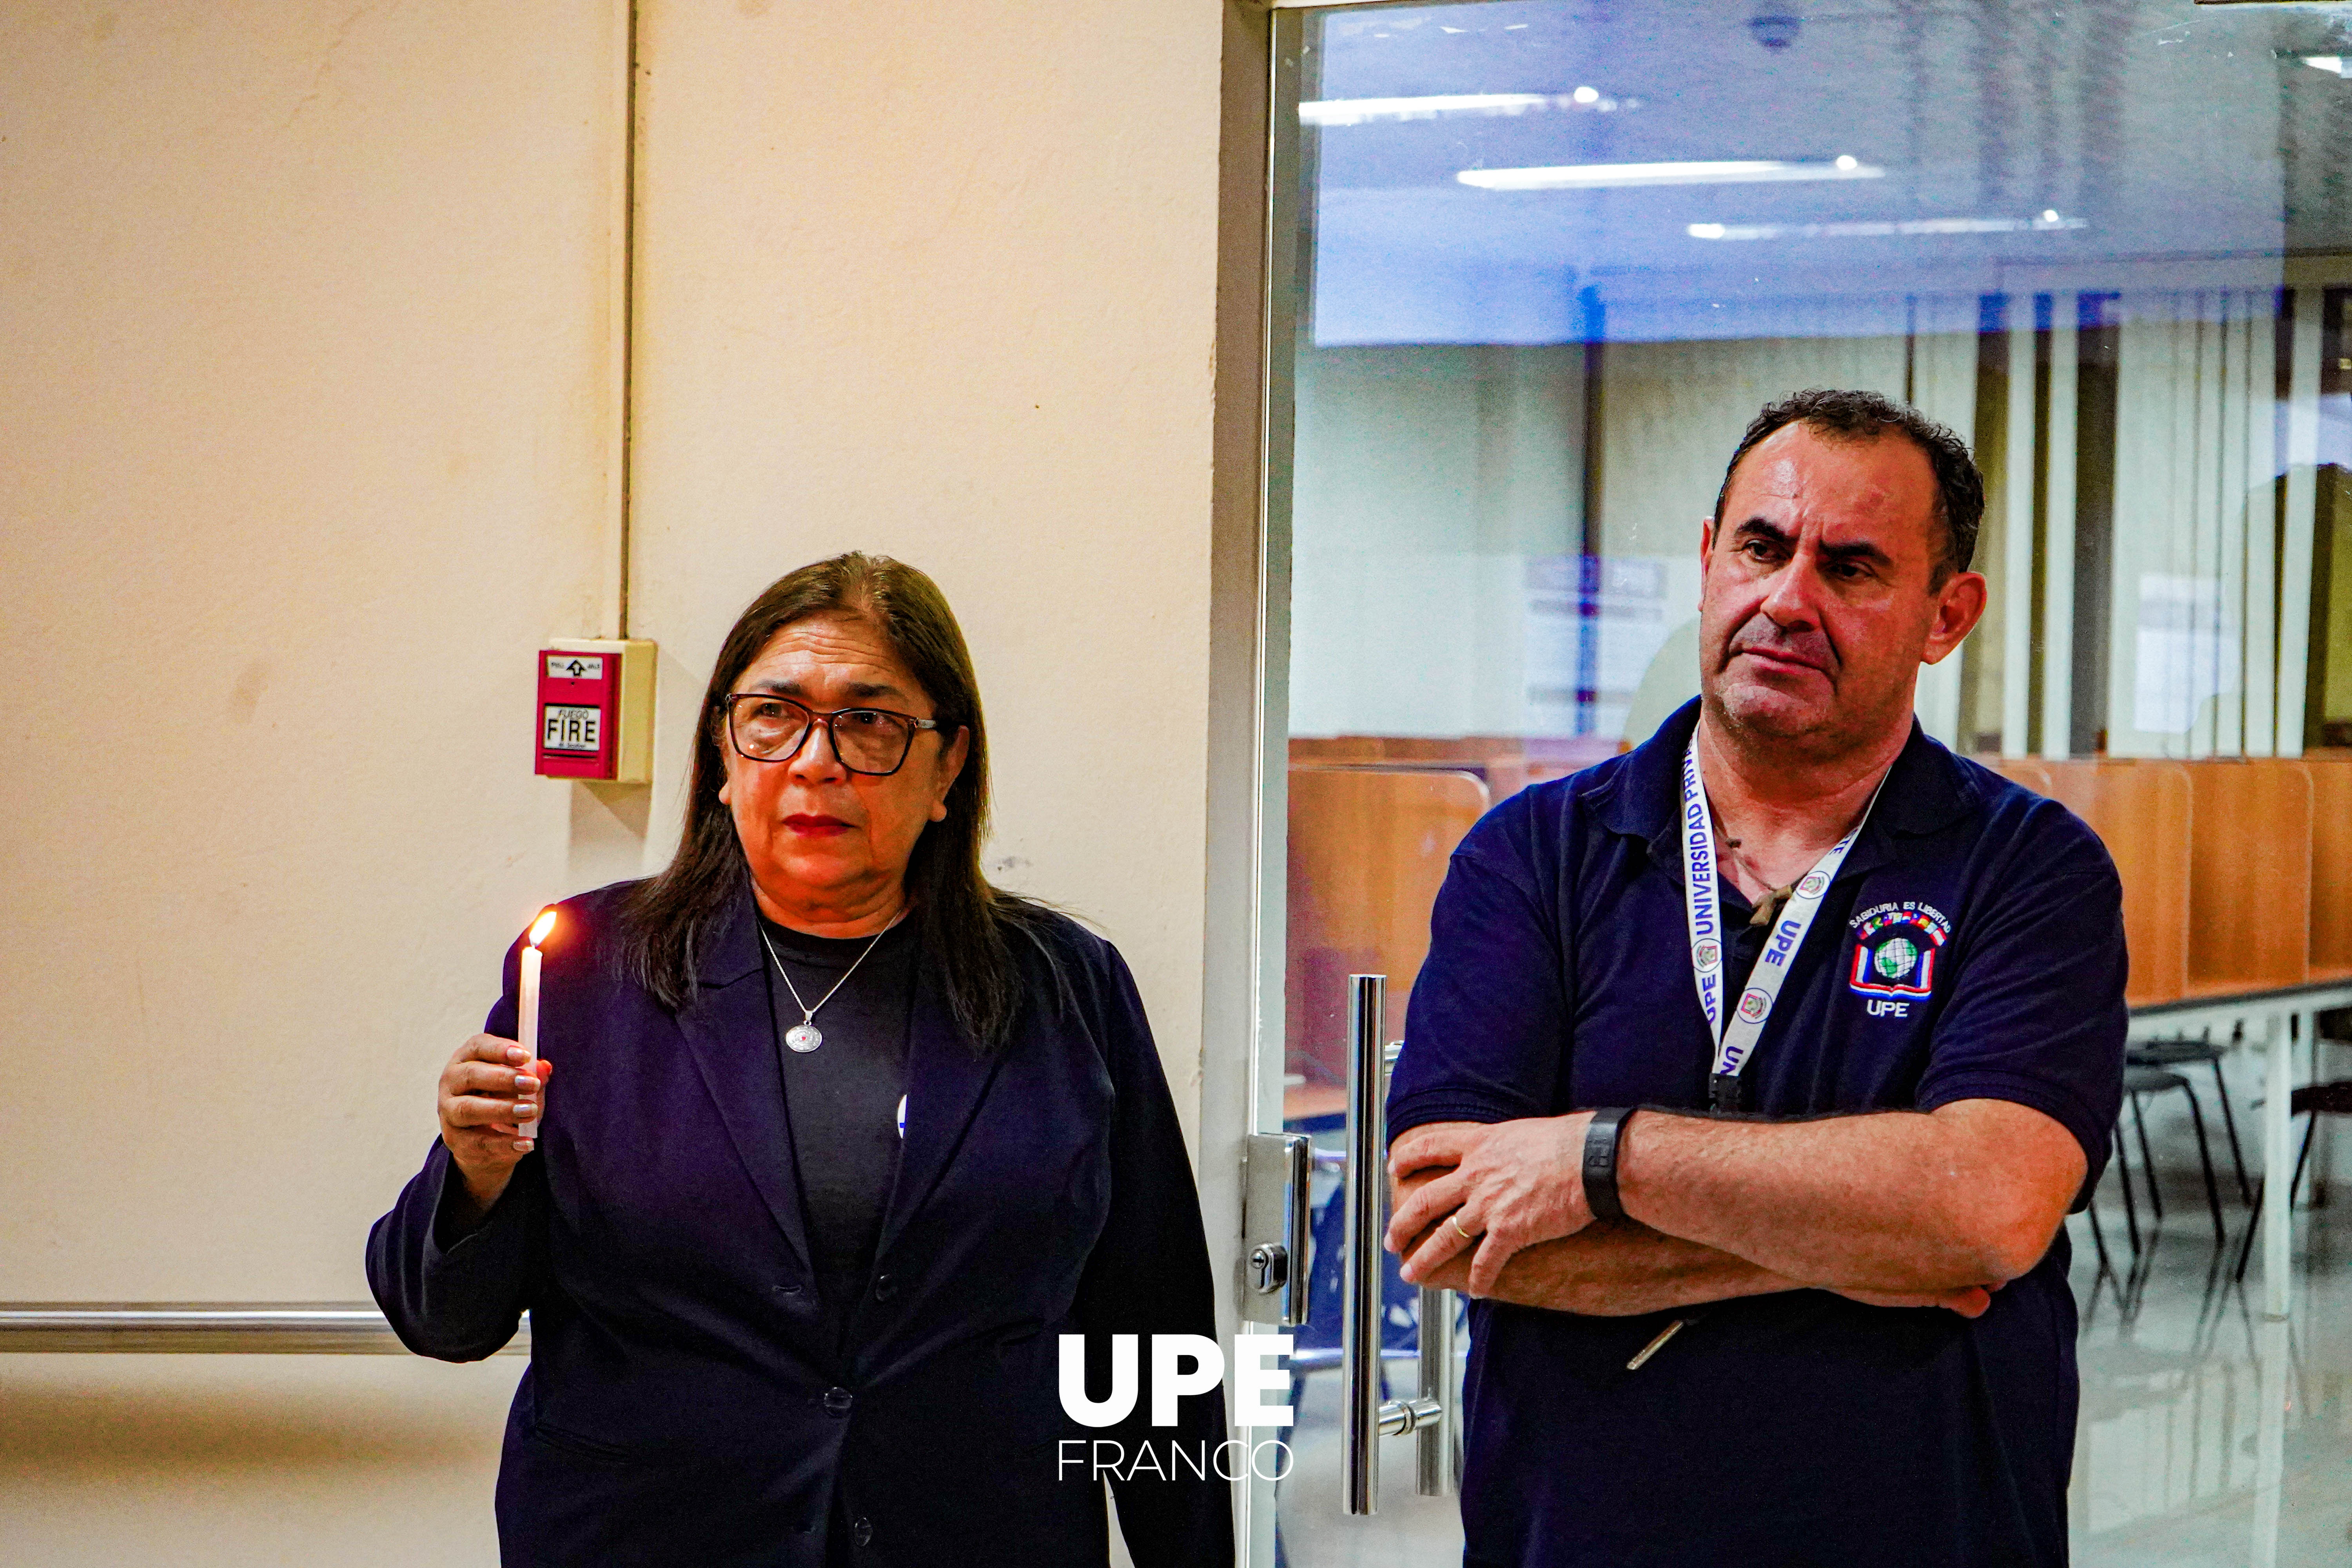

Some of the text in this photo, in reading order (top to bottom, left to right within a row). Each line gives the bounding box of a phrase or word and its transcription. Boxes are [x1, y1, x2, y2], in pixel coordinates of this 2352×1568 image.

[547, 719, 595, 743] FIRE
[1688, 804, 1713, 935] UNIVERSIDAD
[1849, 902, 1951, 933] SABIDURIA ES LIBERTAD
[1765, 920, 1801, 967] UPE
[1702, 974, 1717, 1025] UPE
[1867, 999, 1910, 1017] UPE
